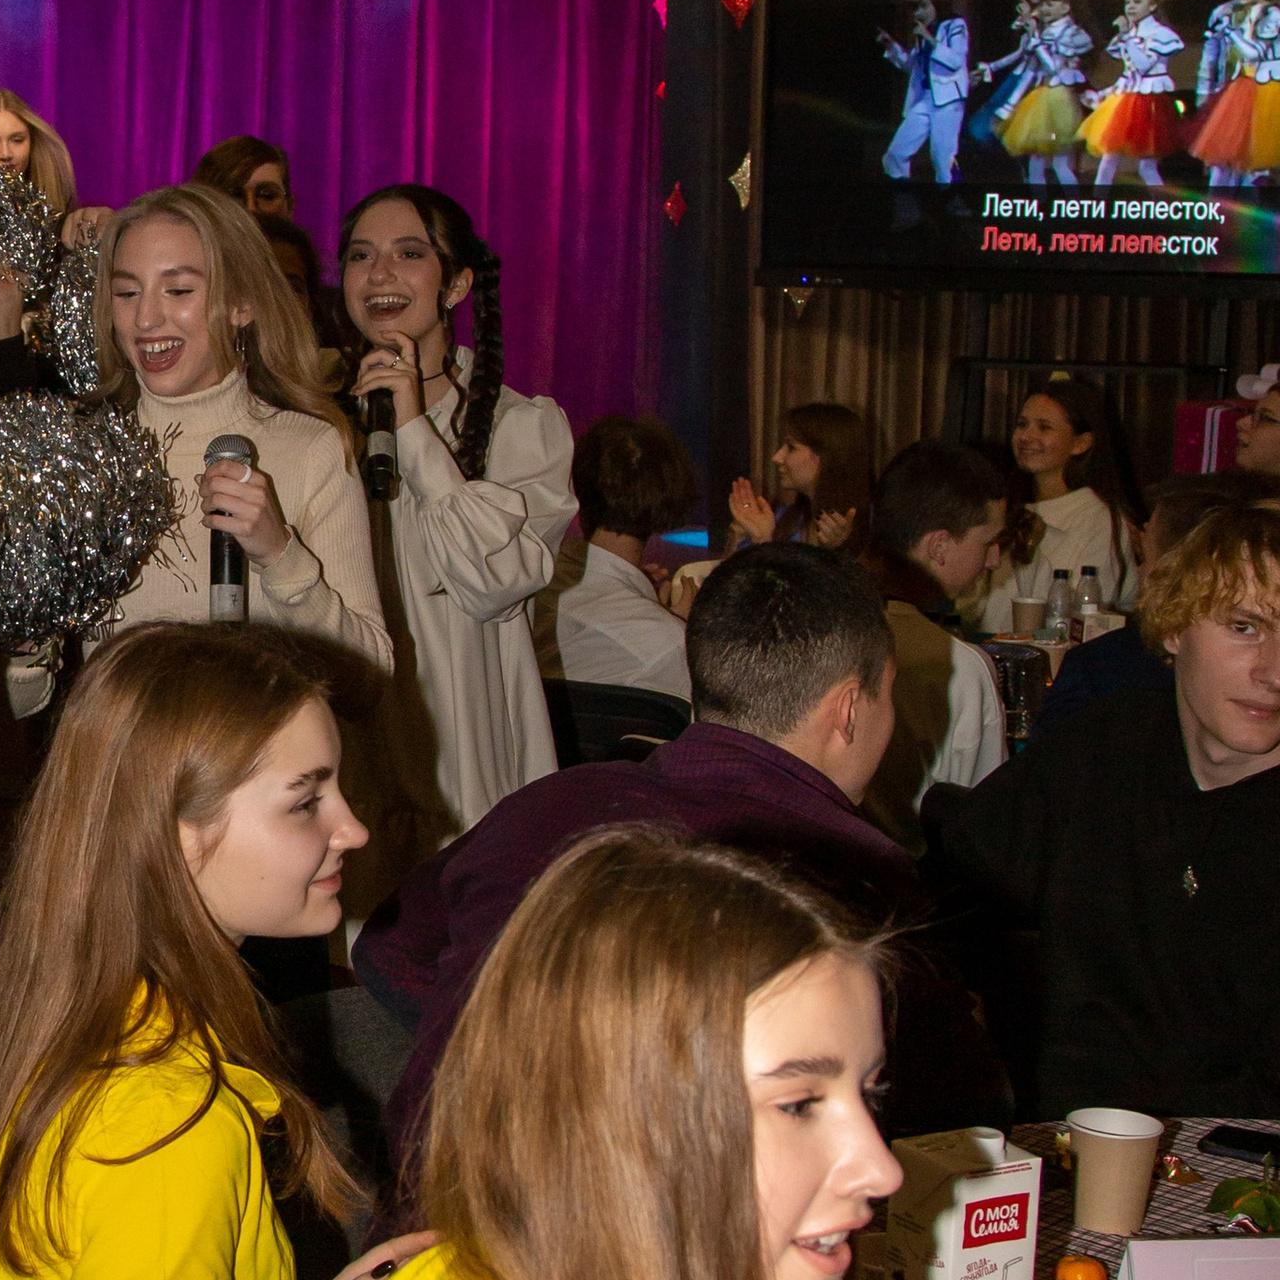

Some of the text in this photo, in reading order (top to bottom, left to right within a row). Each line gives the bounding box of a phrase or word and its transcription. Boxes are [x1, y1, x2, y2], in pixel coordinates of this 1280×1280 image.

[982, 193, 1226, 224] Лети, лети лепесток,
[980, 226, 1218, 255] Лети, лети лепесток
[970, 1208, 1020, 1238] Семья
[986, 1203, 1019, 1222] МОЯ
